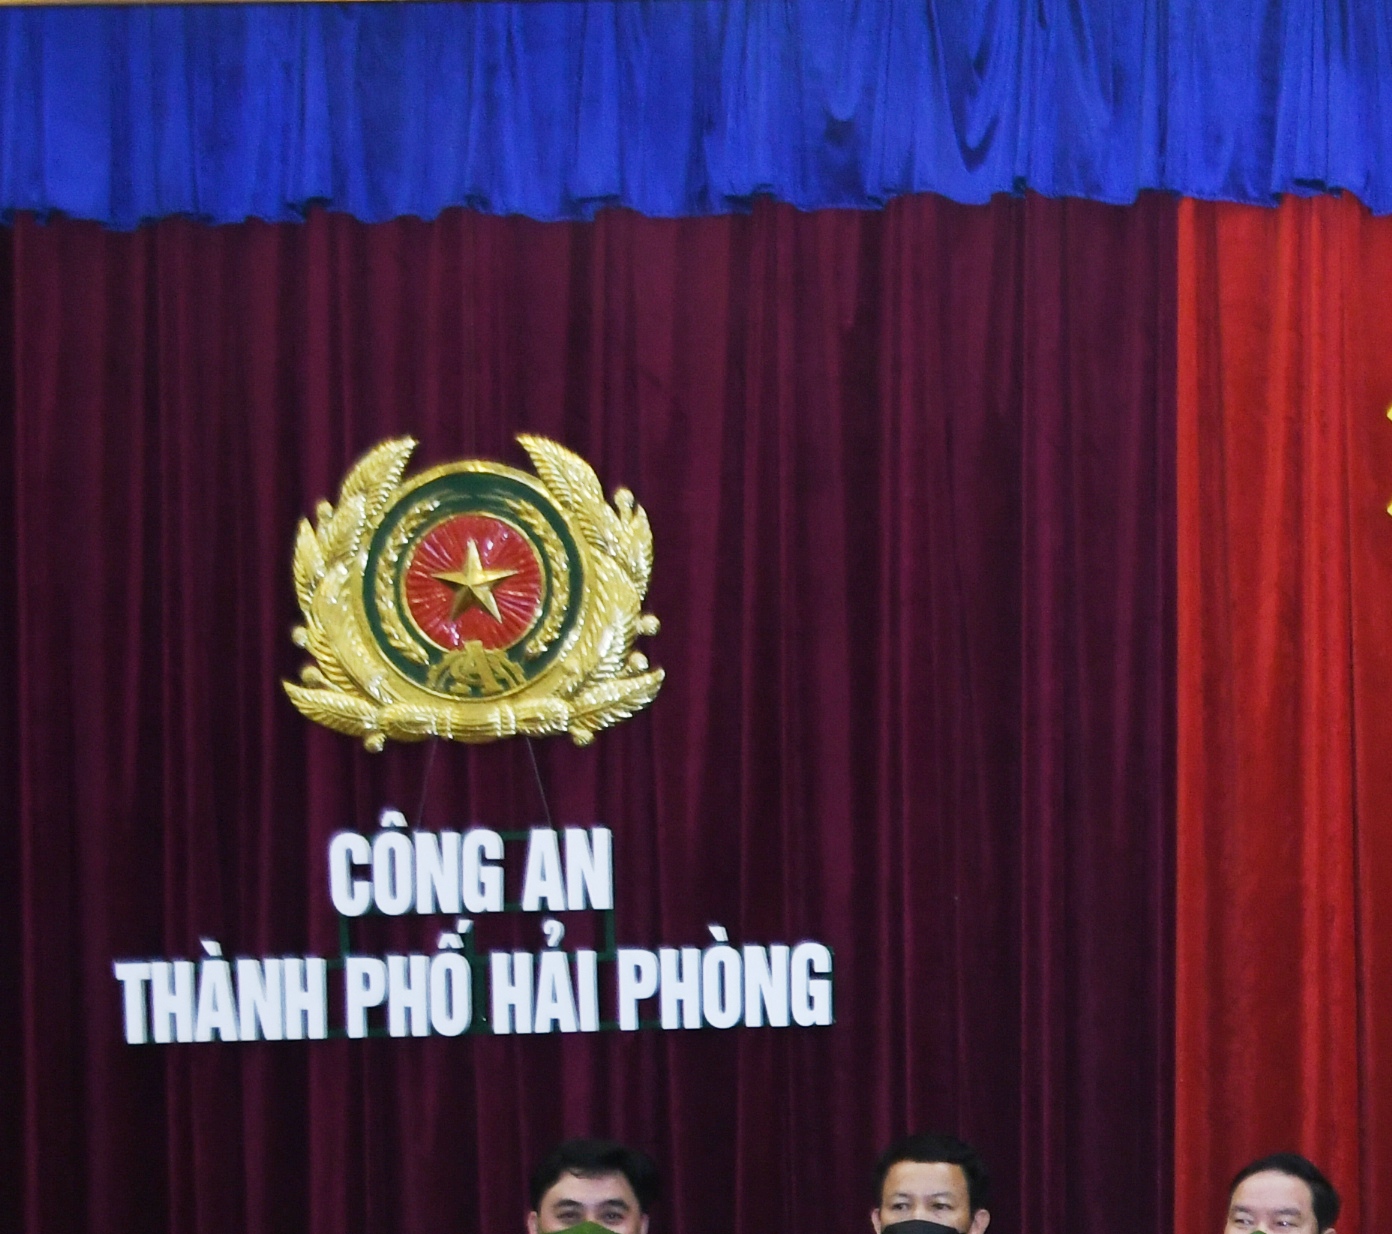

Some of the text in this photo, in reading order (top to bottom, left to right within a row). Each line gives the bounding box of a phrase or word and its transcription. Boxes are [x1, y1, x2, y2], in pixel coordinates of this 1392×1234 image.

[328, 809, 613, 917] CÔNG AN
[113, 919, 834, 1045] THÀNH PHỐ HẢI PHÒNG
